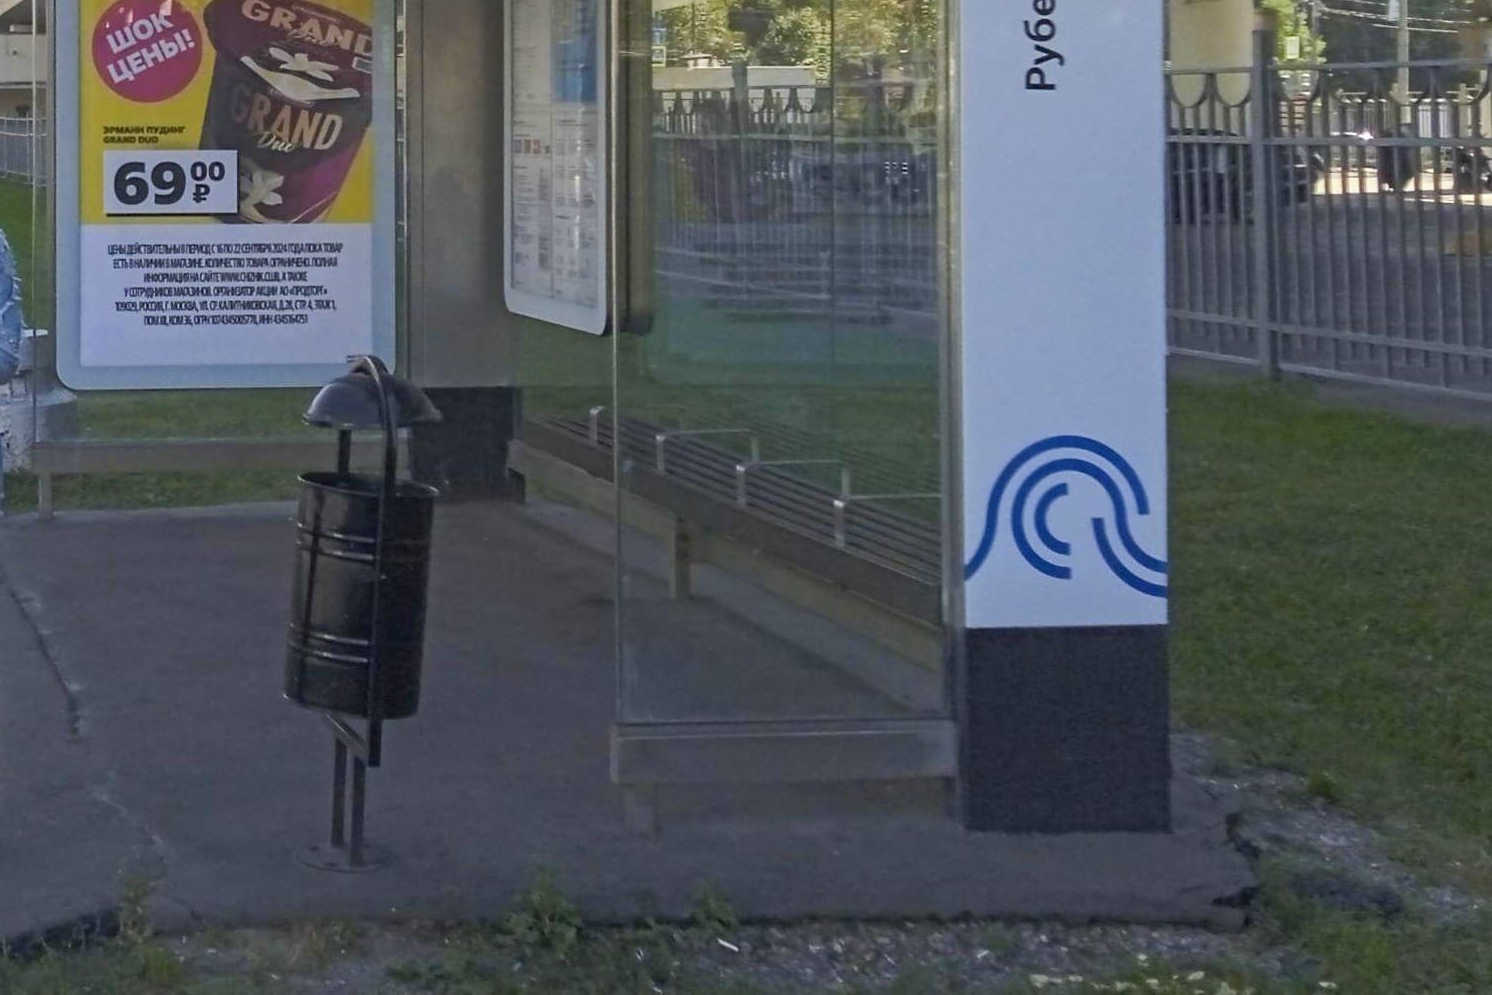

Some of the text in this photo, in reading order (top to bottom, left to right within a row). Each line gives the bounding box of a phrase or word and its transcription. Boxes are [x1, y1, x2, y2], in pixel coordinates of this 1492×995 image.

[106, 12, 174, 54] ШОК
[106, 28, 196, 85] ЦЕНЫ!
[146, 125, 186, 135] ПУДИНГ
[230, 79, 343, 151] GRAND
[102, 135, 160, 144] GRAND DUO
[113, 161, 187, 206] 69
[190, 161, 226, 182] 00
